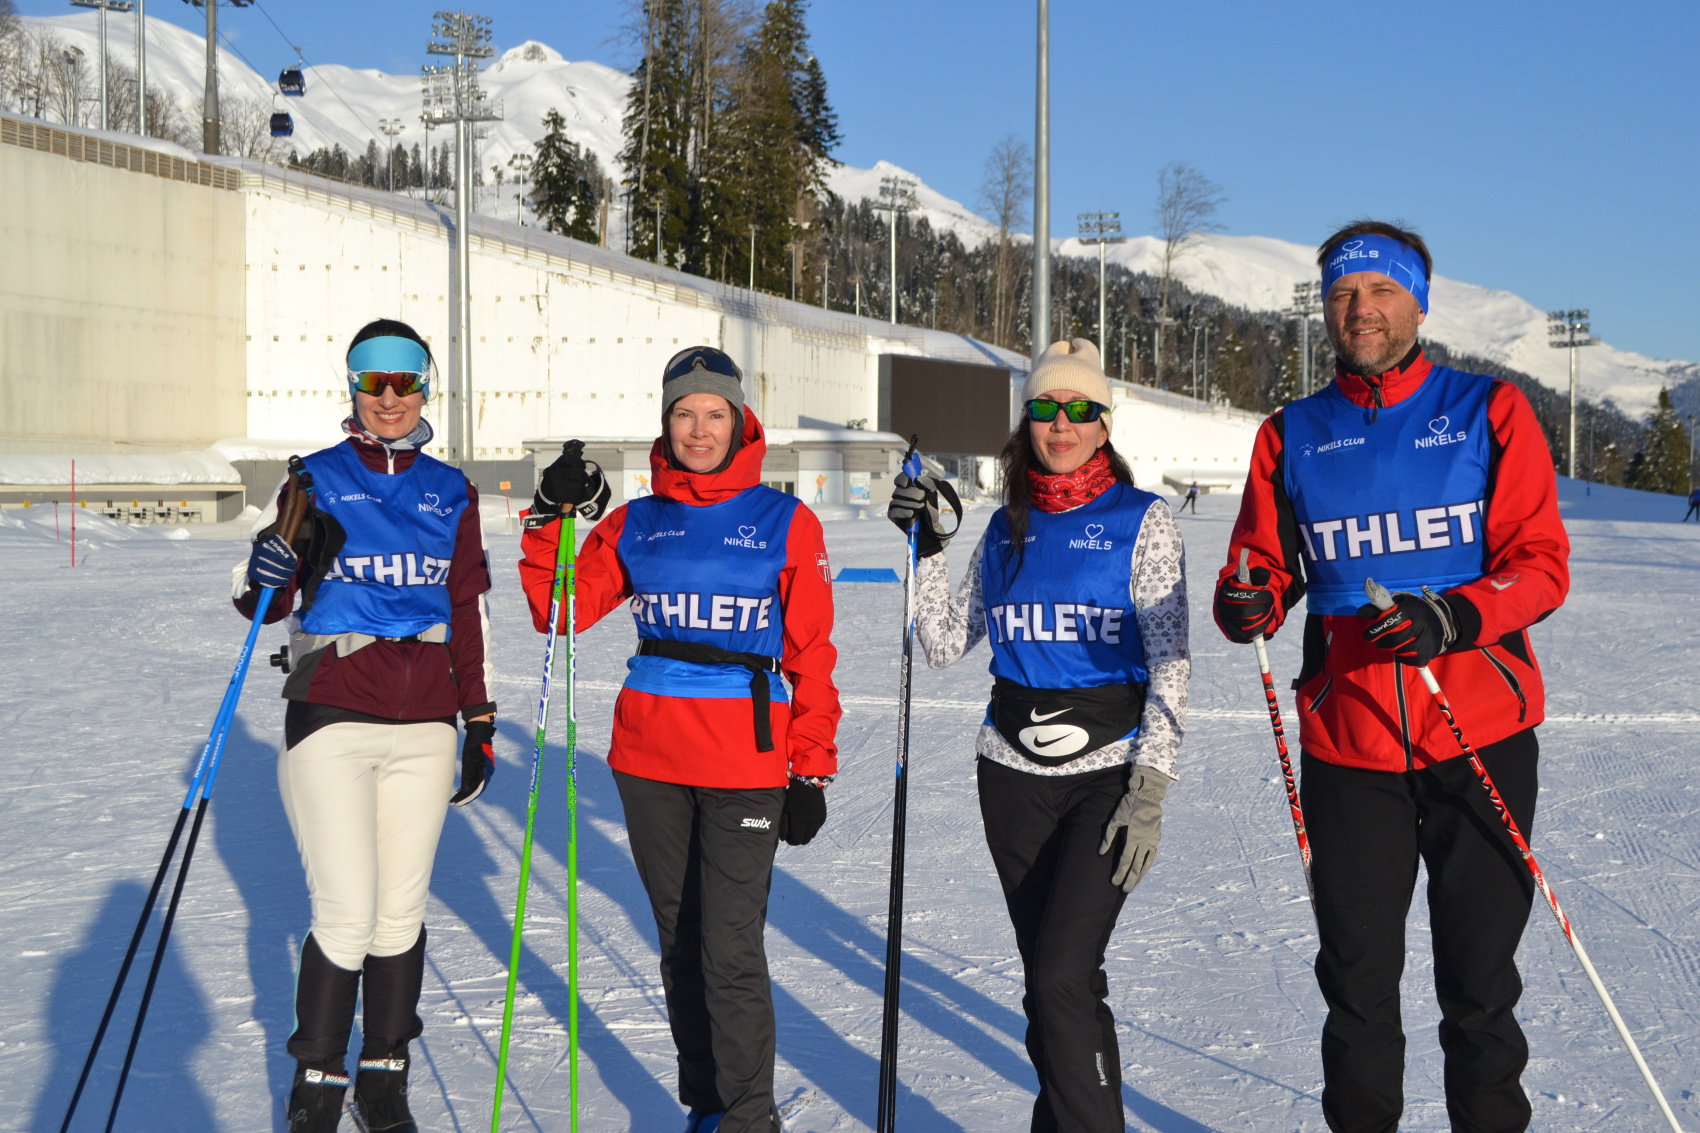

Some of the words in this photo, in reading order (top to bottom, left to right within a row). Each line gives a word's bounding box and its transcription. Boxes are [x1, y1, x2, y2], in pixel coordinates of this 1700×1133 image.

[1329, 249, 1380, 270] NIKELS
[1316, 440, 1342, 454] NIKELS
[1343, 437, 1366, 447] CLUB
[1414, 430, 1467, 449] NIKELS
[341, 493, 366, 502] NIKELS
[418, 502, 453, 517] NIKELS
[1299, 500, 1485, 562] THLET
[724, 537, 767, 549] NIKELS
[1069, 539, 1113, 550] NIKELS
[629, 591, 773, 632] ATHLETE
[984, 602, 1124, 645] THLETE
